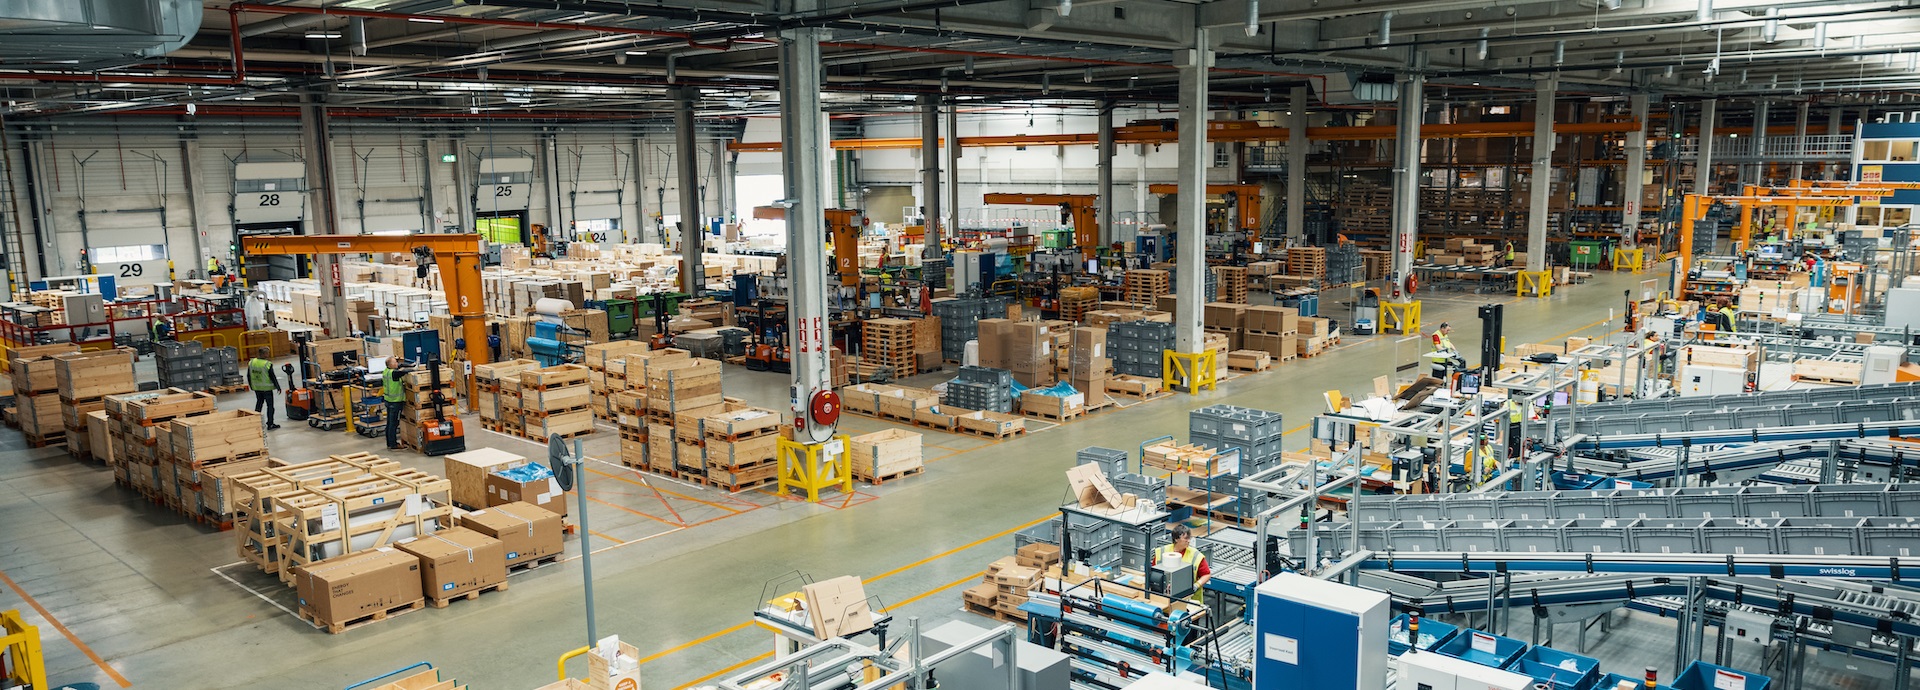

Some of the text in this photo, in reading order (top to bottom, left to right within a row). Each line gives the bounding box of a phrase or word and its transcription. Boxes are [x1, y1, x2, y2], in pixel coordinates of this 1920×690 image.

[496, 186, 512, 198] 25
[259, 193, 281, 207] 28
[593, 232, 607, 243] 24
[840, 257, 851, 268] 12
[120, 263, 143, 278] 29
[461, 296, 469, 308] 3
[1819, 567, 1856, 576] swisslog
[331, 582, 350, 591] ENERGY
[332, 589, 354, 599] CHANGES
